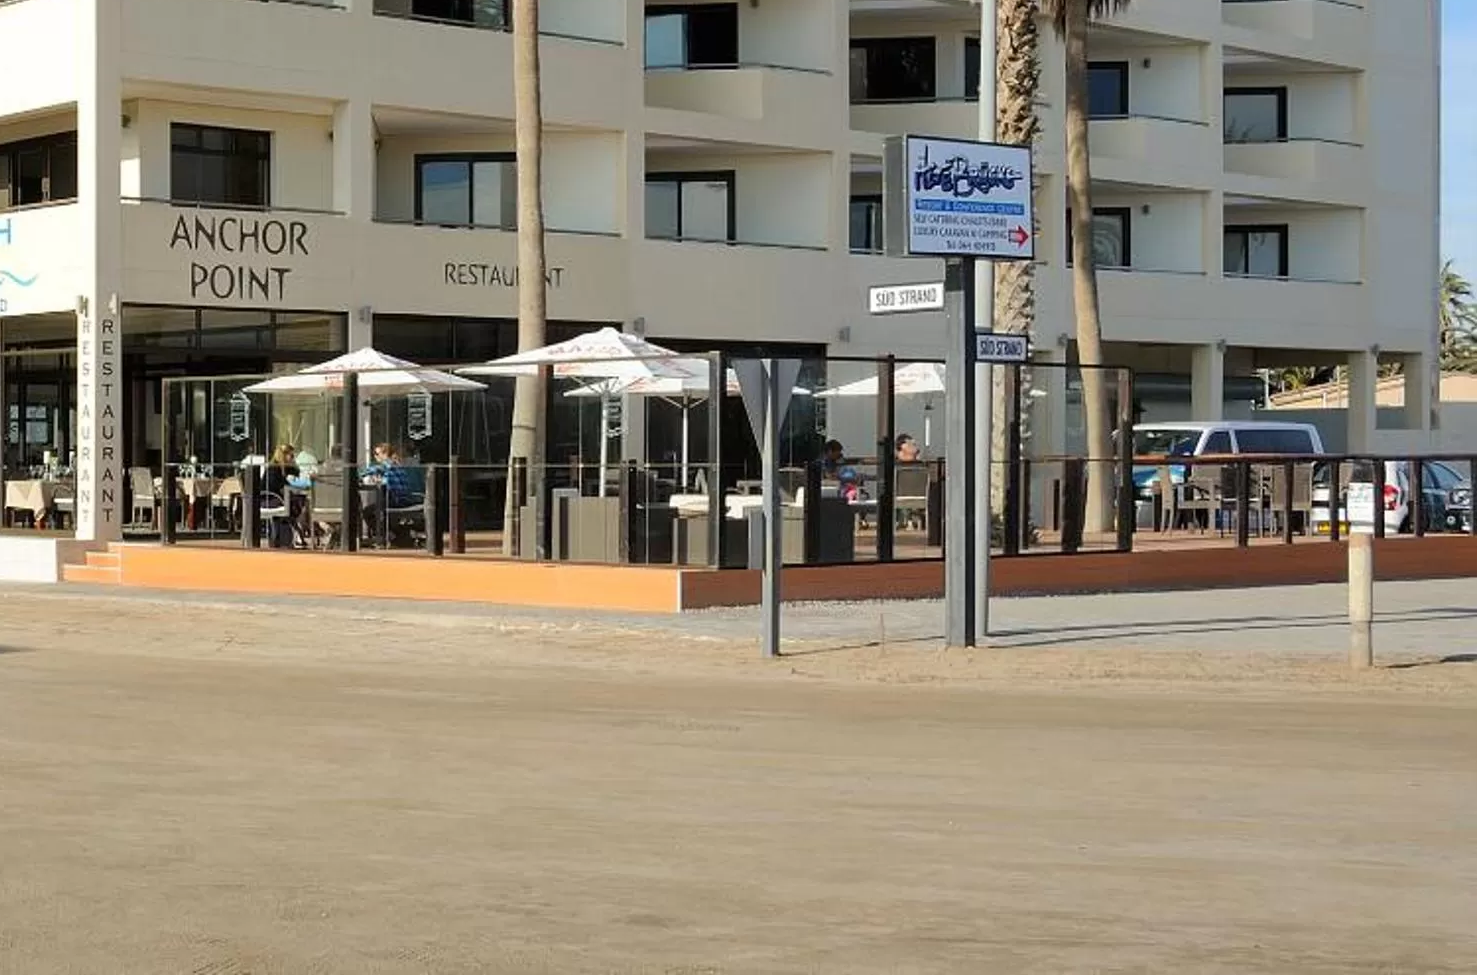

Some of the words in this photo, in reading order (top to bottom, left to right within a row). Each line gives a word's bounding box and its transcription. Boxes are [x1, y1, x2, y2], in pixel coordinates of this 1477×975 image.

[170, 213, 309, 256] ANCHOR
[191, 262, 292, 301] POINT
[899, 288, 937, 305] STRAND
[81, 319, 91, 523] RESTAURANT
[101, 319, 114, 523] RESTAURANT
